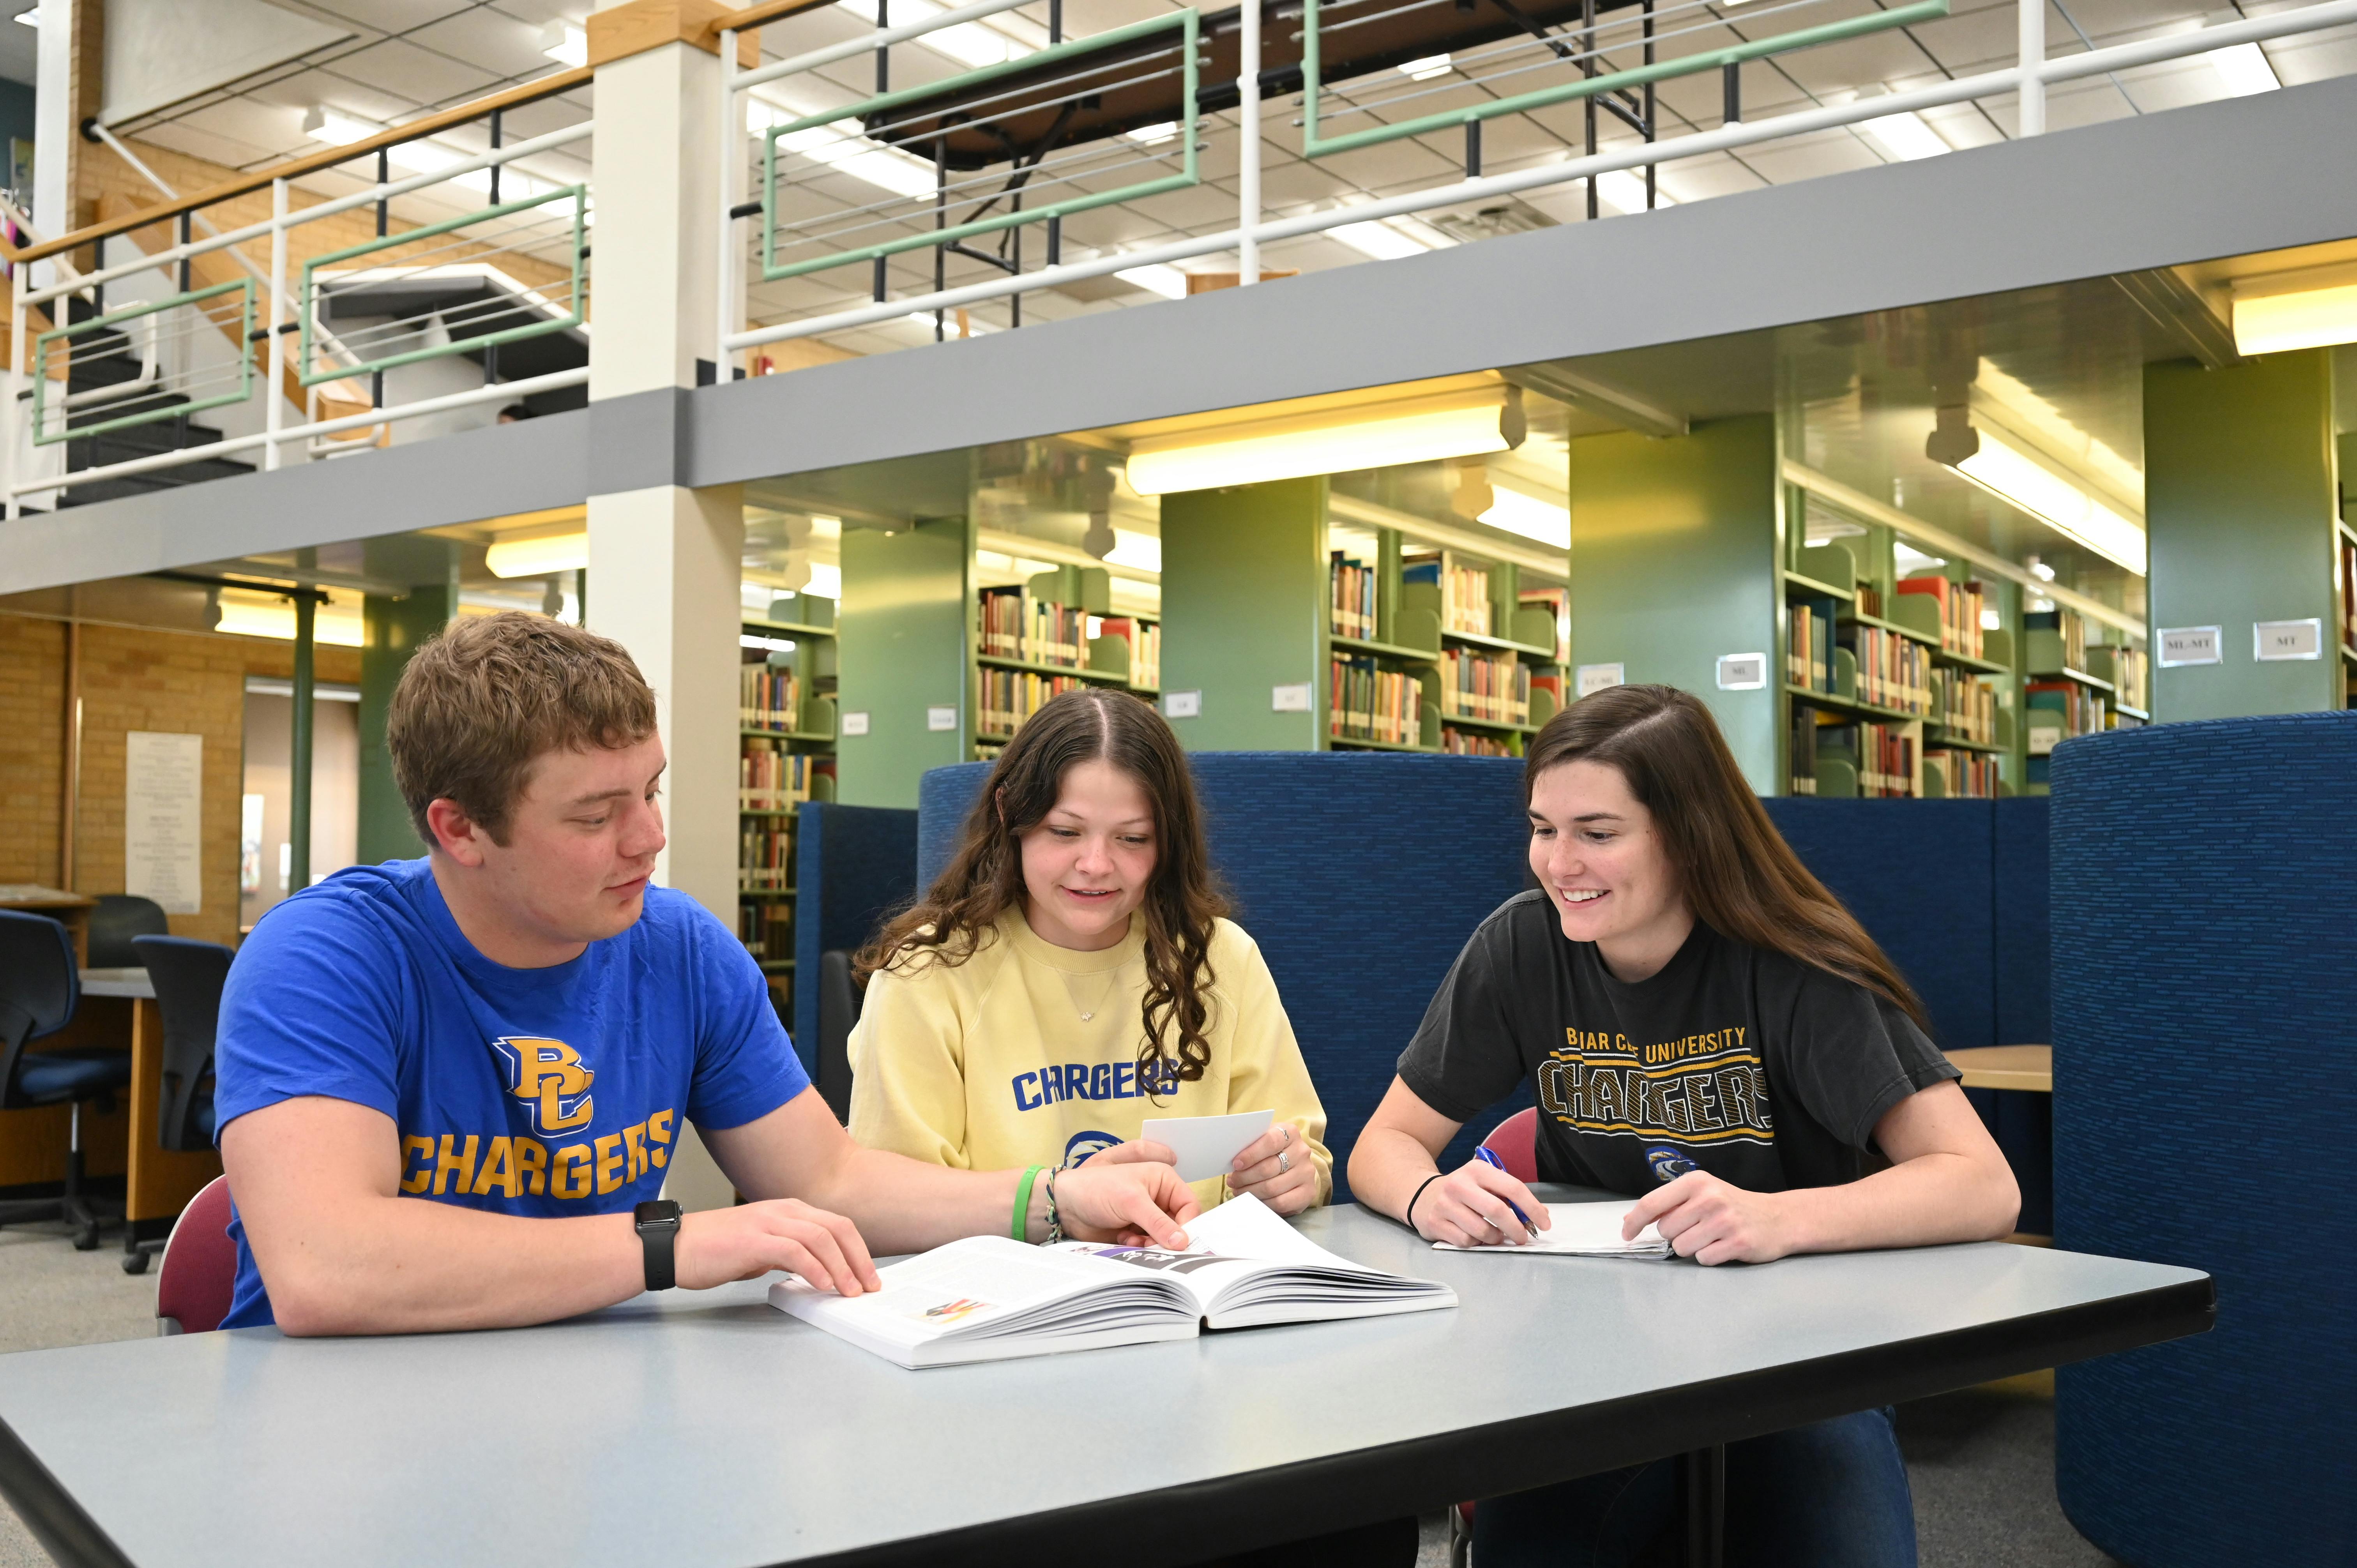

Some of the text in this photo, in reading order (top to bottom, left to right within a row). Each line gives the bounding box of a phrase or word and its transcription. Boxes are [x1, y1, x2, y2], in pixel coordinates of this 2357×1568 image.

[2276, 636, 2296, 646] MT
[1646, 1027, 1745, 1063] UNIVERSITY
[400, 1108, 673, 1199] CHARGERS
